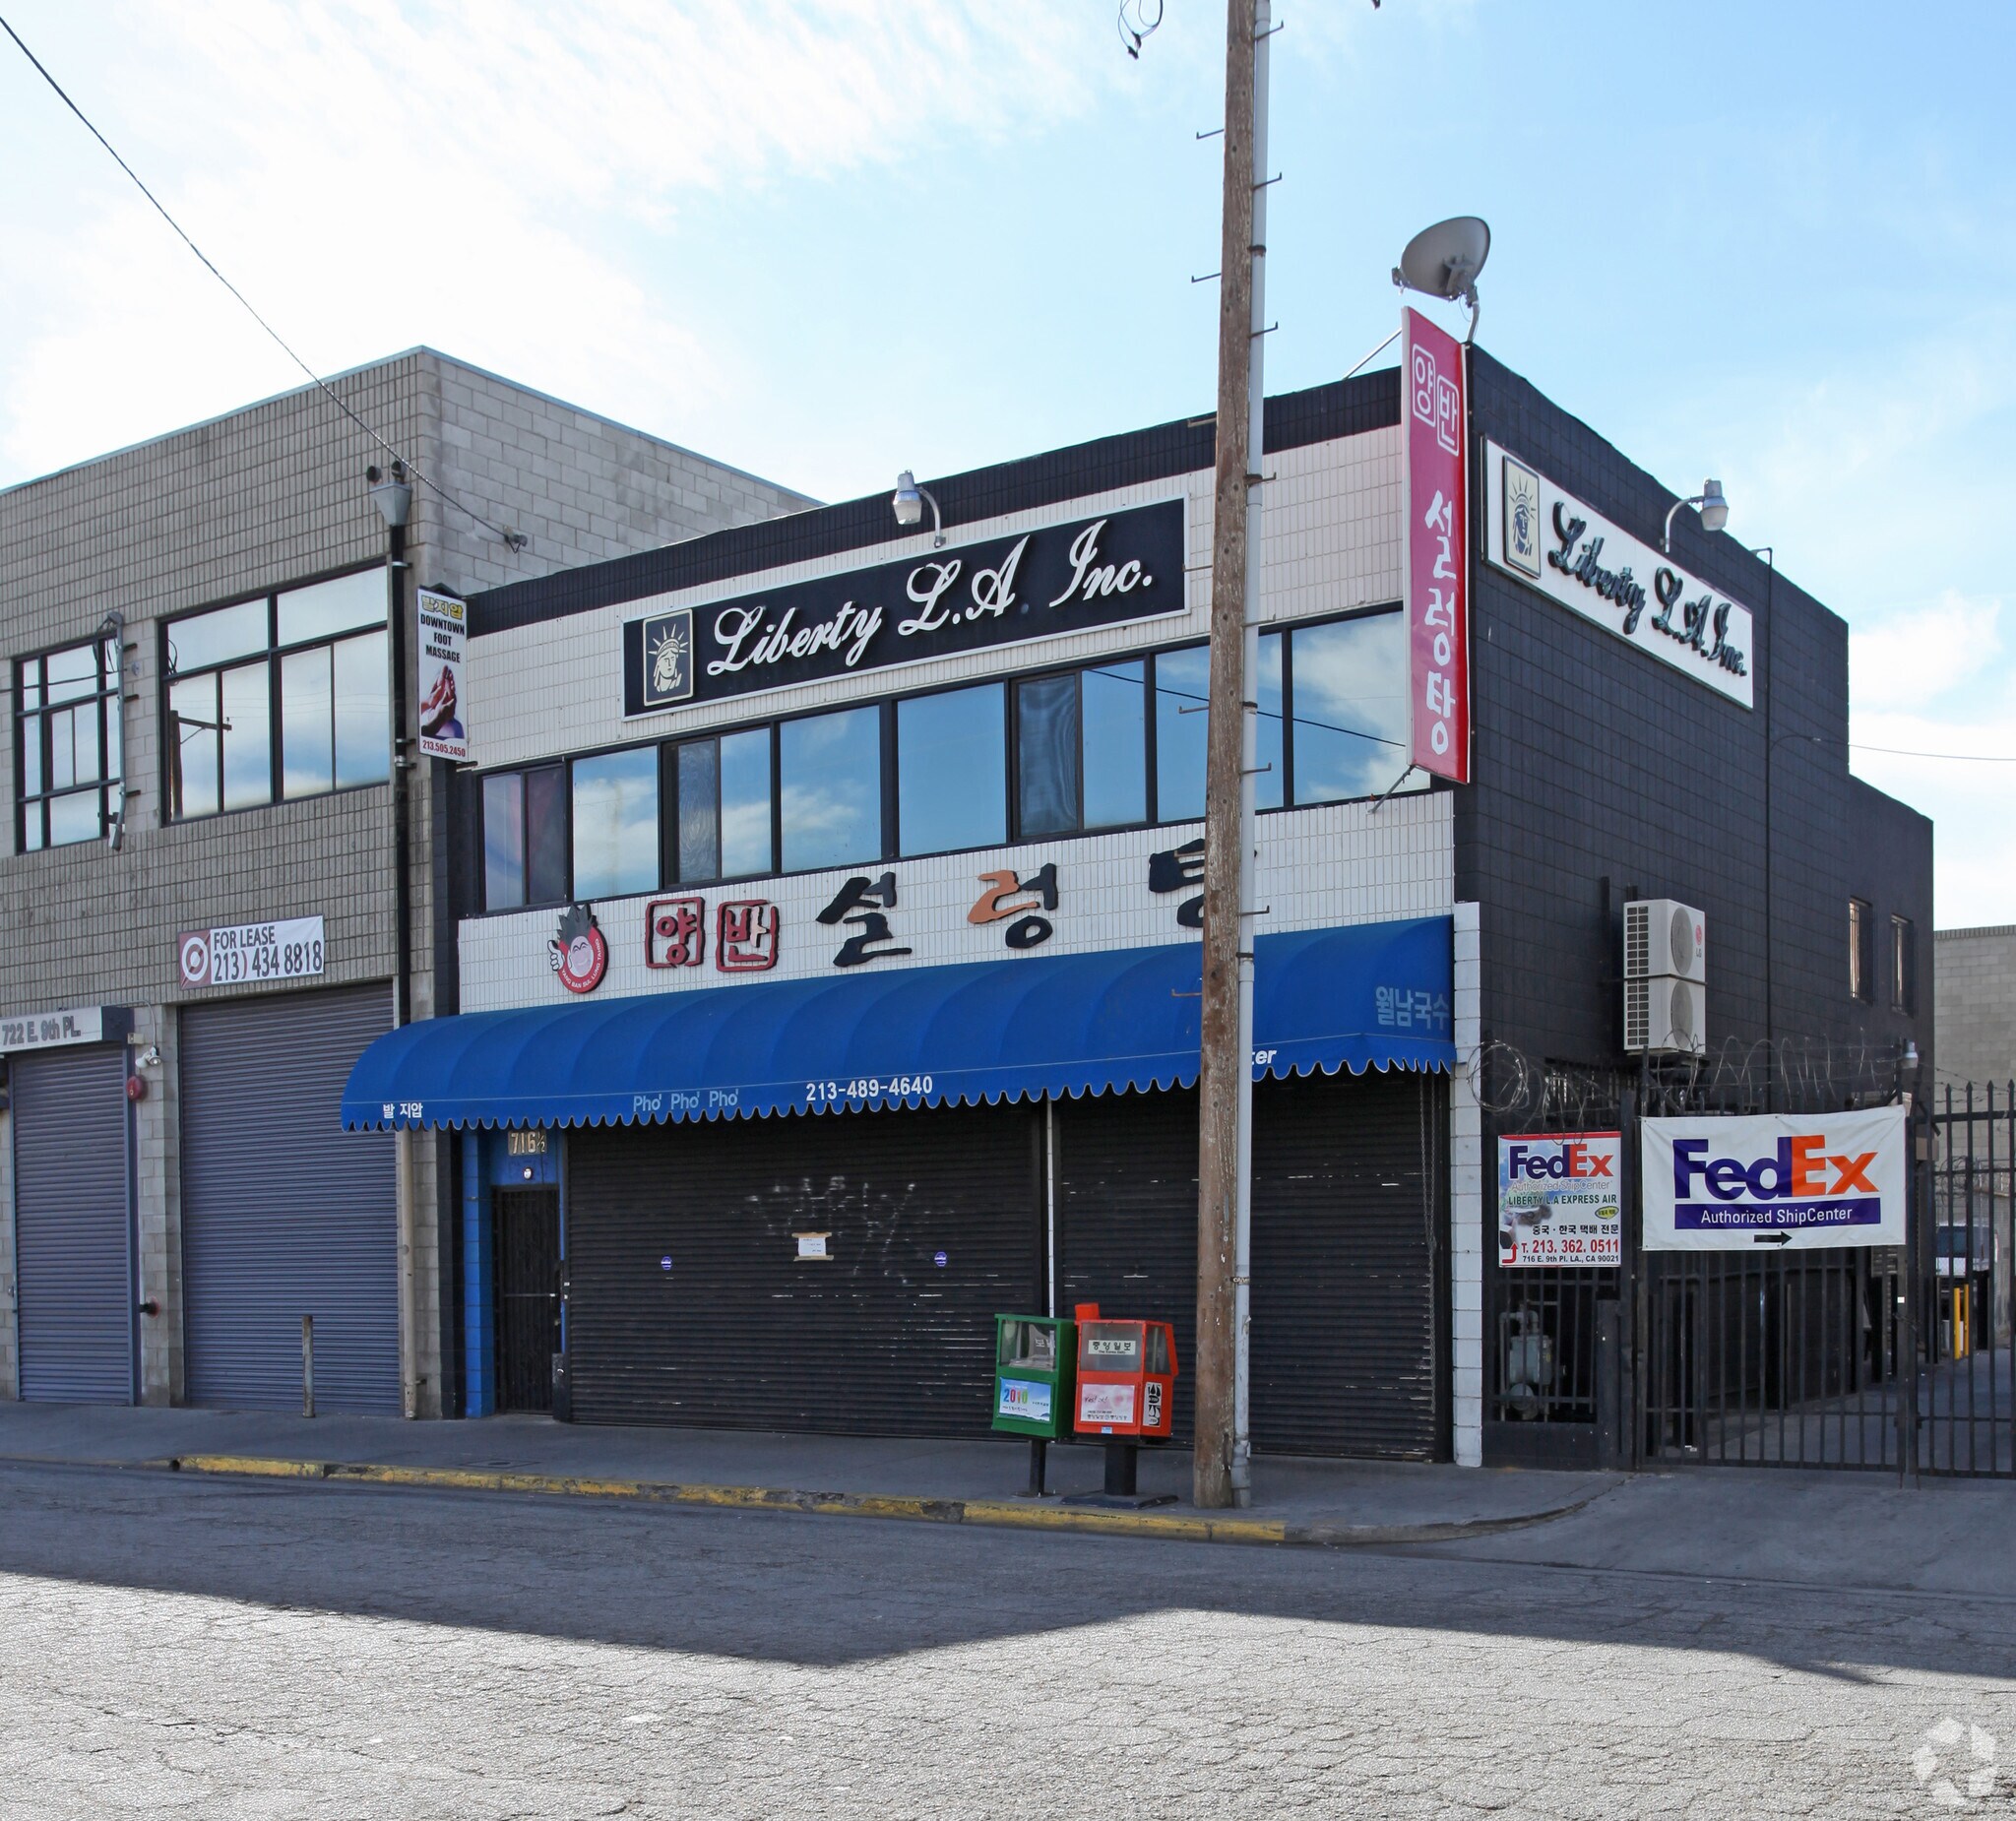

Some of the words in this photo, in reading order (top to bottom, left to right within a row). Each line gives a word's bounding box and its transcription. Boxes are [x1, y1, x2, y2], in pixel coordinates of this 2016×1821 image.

[707, 600, 883, 676] Liberty
[1049, 519, 1153, 608] Inc.
[1547, 501, 1646, 635] Liberty
[1708, 602, 1747, 677] Inc.
[420, 595, 465, 620] 발지압
[420, 613, 465, 635] DOWNTOWN
[1423, 490, 1457, 755] 설렁탕
[433, 632, 452, 647] FOOT
[425, 645, 461, 663] MASSAGE
[422, 740, 466, 757] 213.505.2450
[214, 930, 237, 951] FOR
[240, 925, 276, 947] LEASE
[655, 907, 772, 965] 양반
[214, 950, 247, 981] 213)
[252, 946, 281, 977] 434
[284, 940, 323, 974] 8818
[1375, 985, 1450, 1031] 월남국수
[2, 1023, 25, 1045] 722
[40, 1018, 60, 1040] 9th
[805, 1075, 933, 1101] 213-489-4640
[383, 1102, 395, 1119] 발
[400, 1102, 423, 1118] 지압
[1509, 1144, 1614, 1179] FedEx
[1672, 1135, 1879, 1201] FedEx
[1512, 1181, 1559, 1192] Authorized
[1560, 1180, 1609, 1191] ShipCenter
[1508, 1196, 1543, 1205] LIBERTY
[1561, 1194, 1600, 1204] EXPRESS
[1602, 1194, 1616, 1203] AIR
[1701, 1209, 1772, 1224] Authorized
[1777, 1207, 1853, 1225] ShipCenter
[1559, 1224, 1576, 1234] 한국
[1580, 1224, 1598, 1234] 택배
[1601, 1224, 1618, 1234] 전문
[1521, 1243, 1529, 1253] T.
[1533, 1239, 1557, 1253] 213.
[1561, 1239, 1586, 1253] 362.
[1590, 1239, 1618, 1252] 0511
[1093, 1342, 1131, 1350] 중앙일보
[1002, 1388, 1029, 1404] 2010
